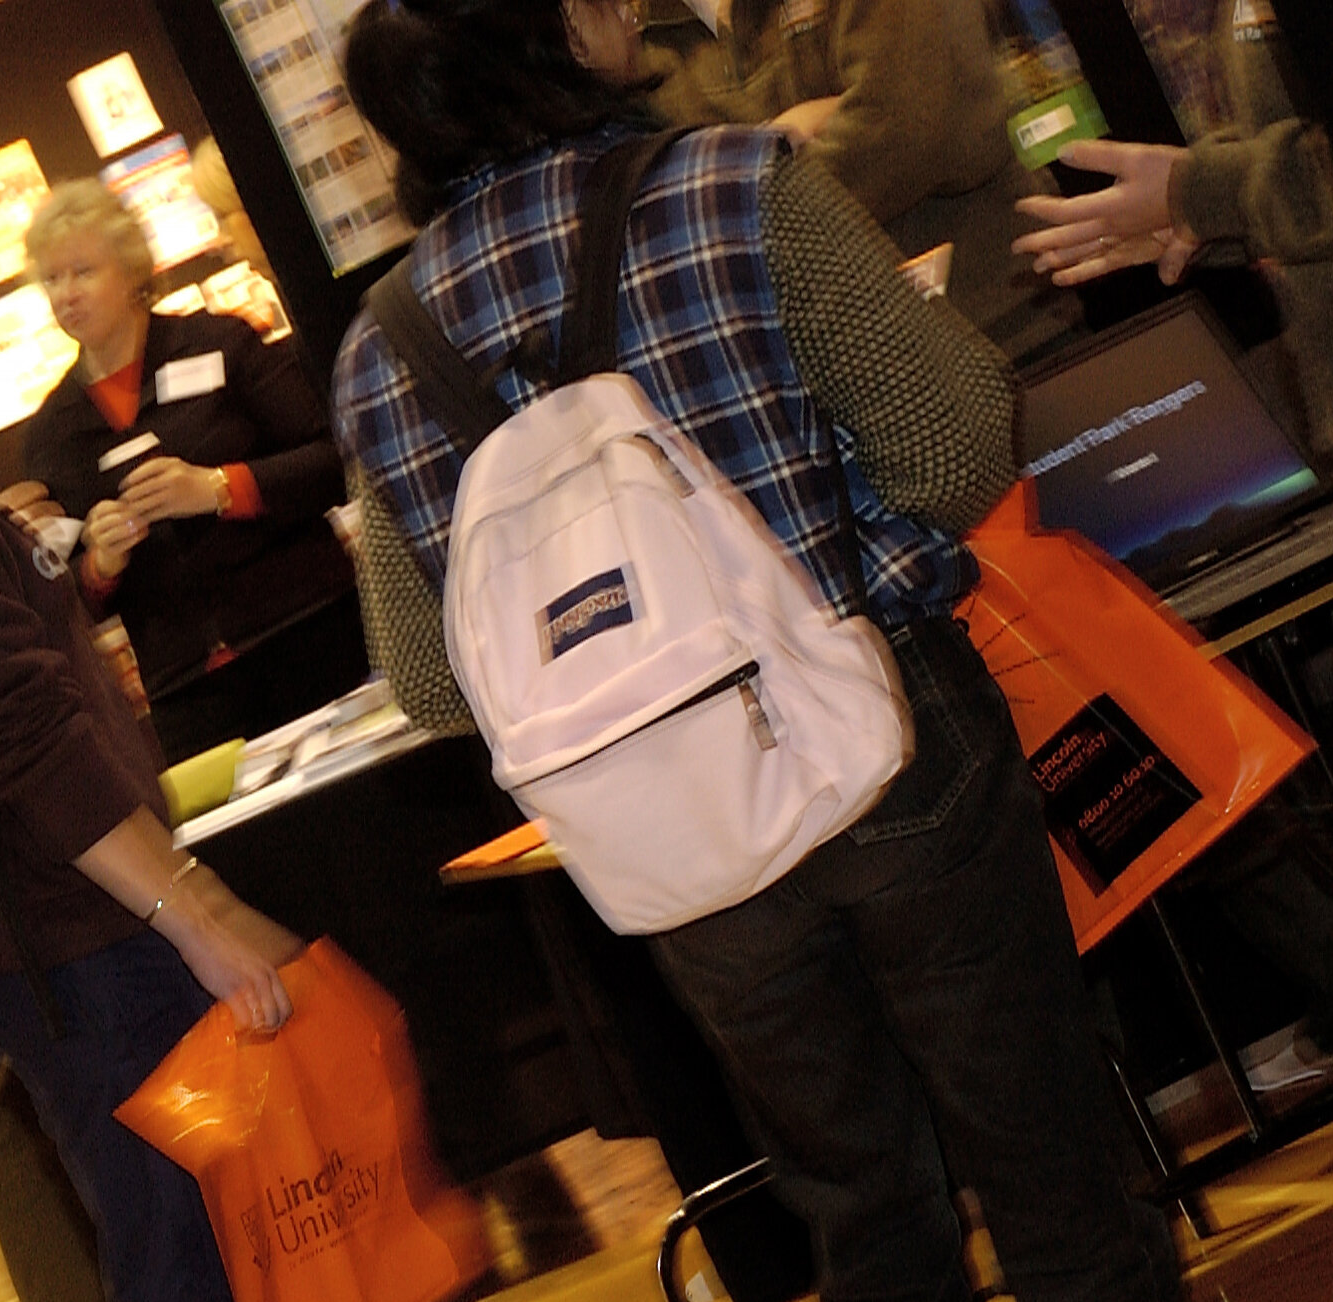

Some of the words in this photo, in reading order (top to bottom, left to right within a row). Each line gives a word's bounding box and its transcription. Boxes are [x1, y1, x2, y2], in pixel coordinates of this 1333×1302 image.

[1032, 733, 1082, 783] Lincoln
[1042, 732, 1107, 791] University
[275, 1162, 380, 1255] Univsity
